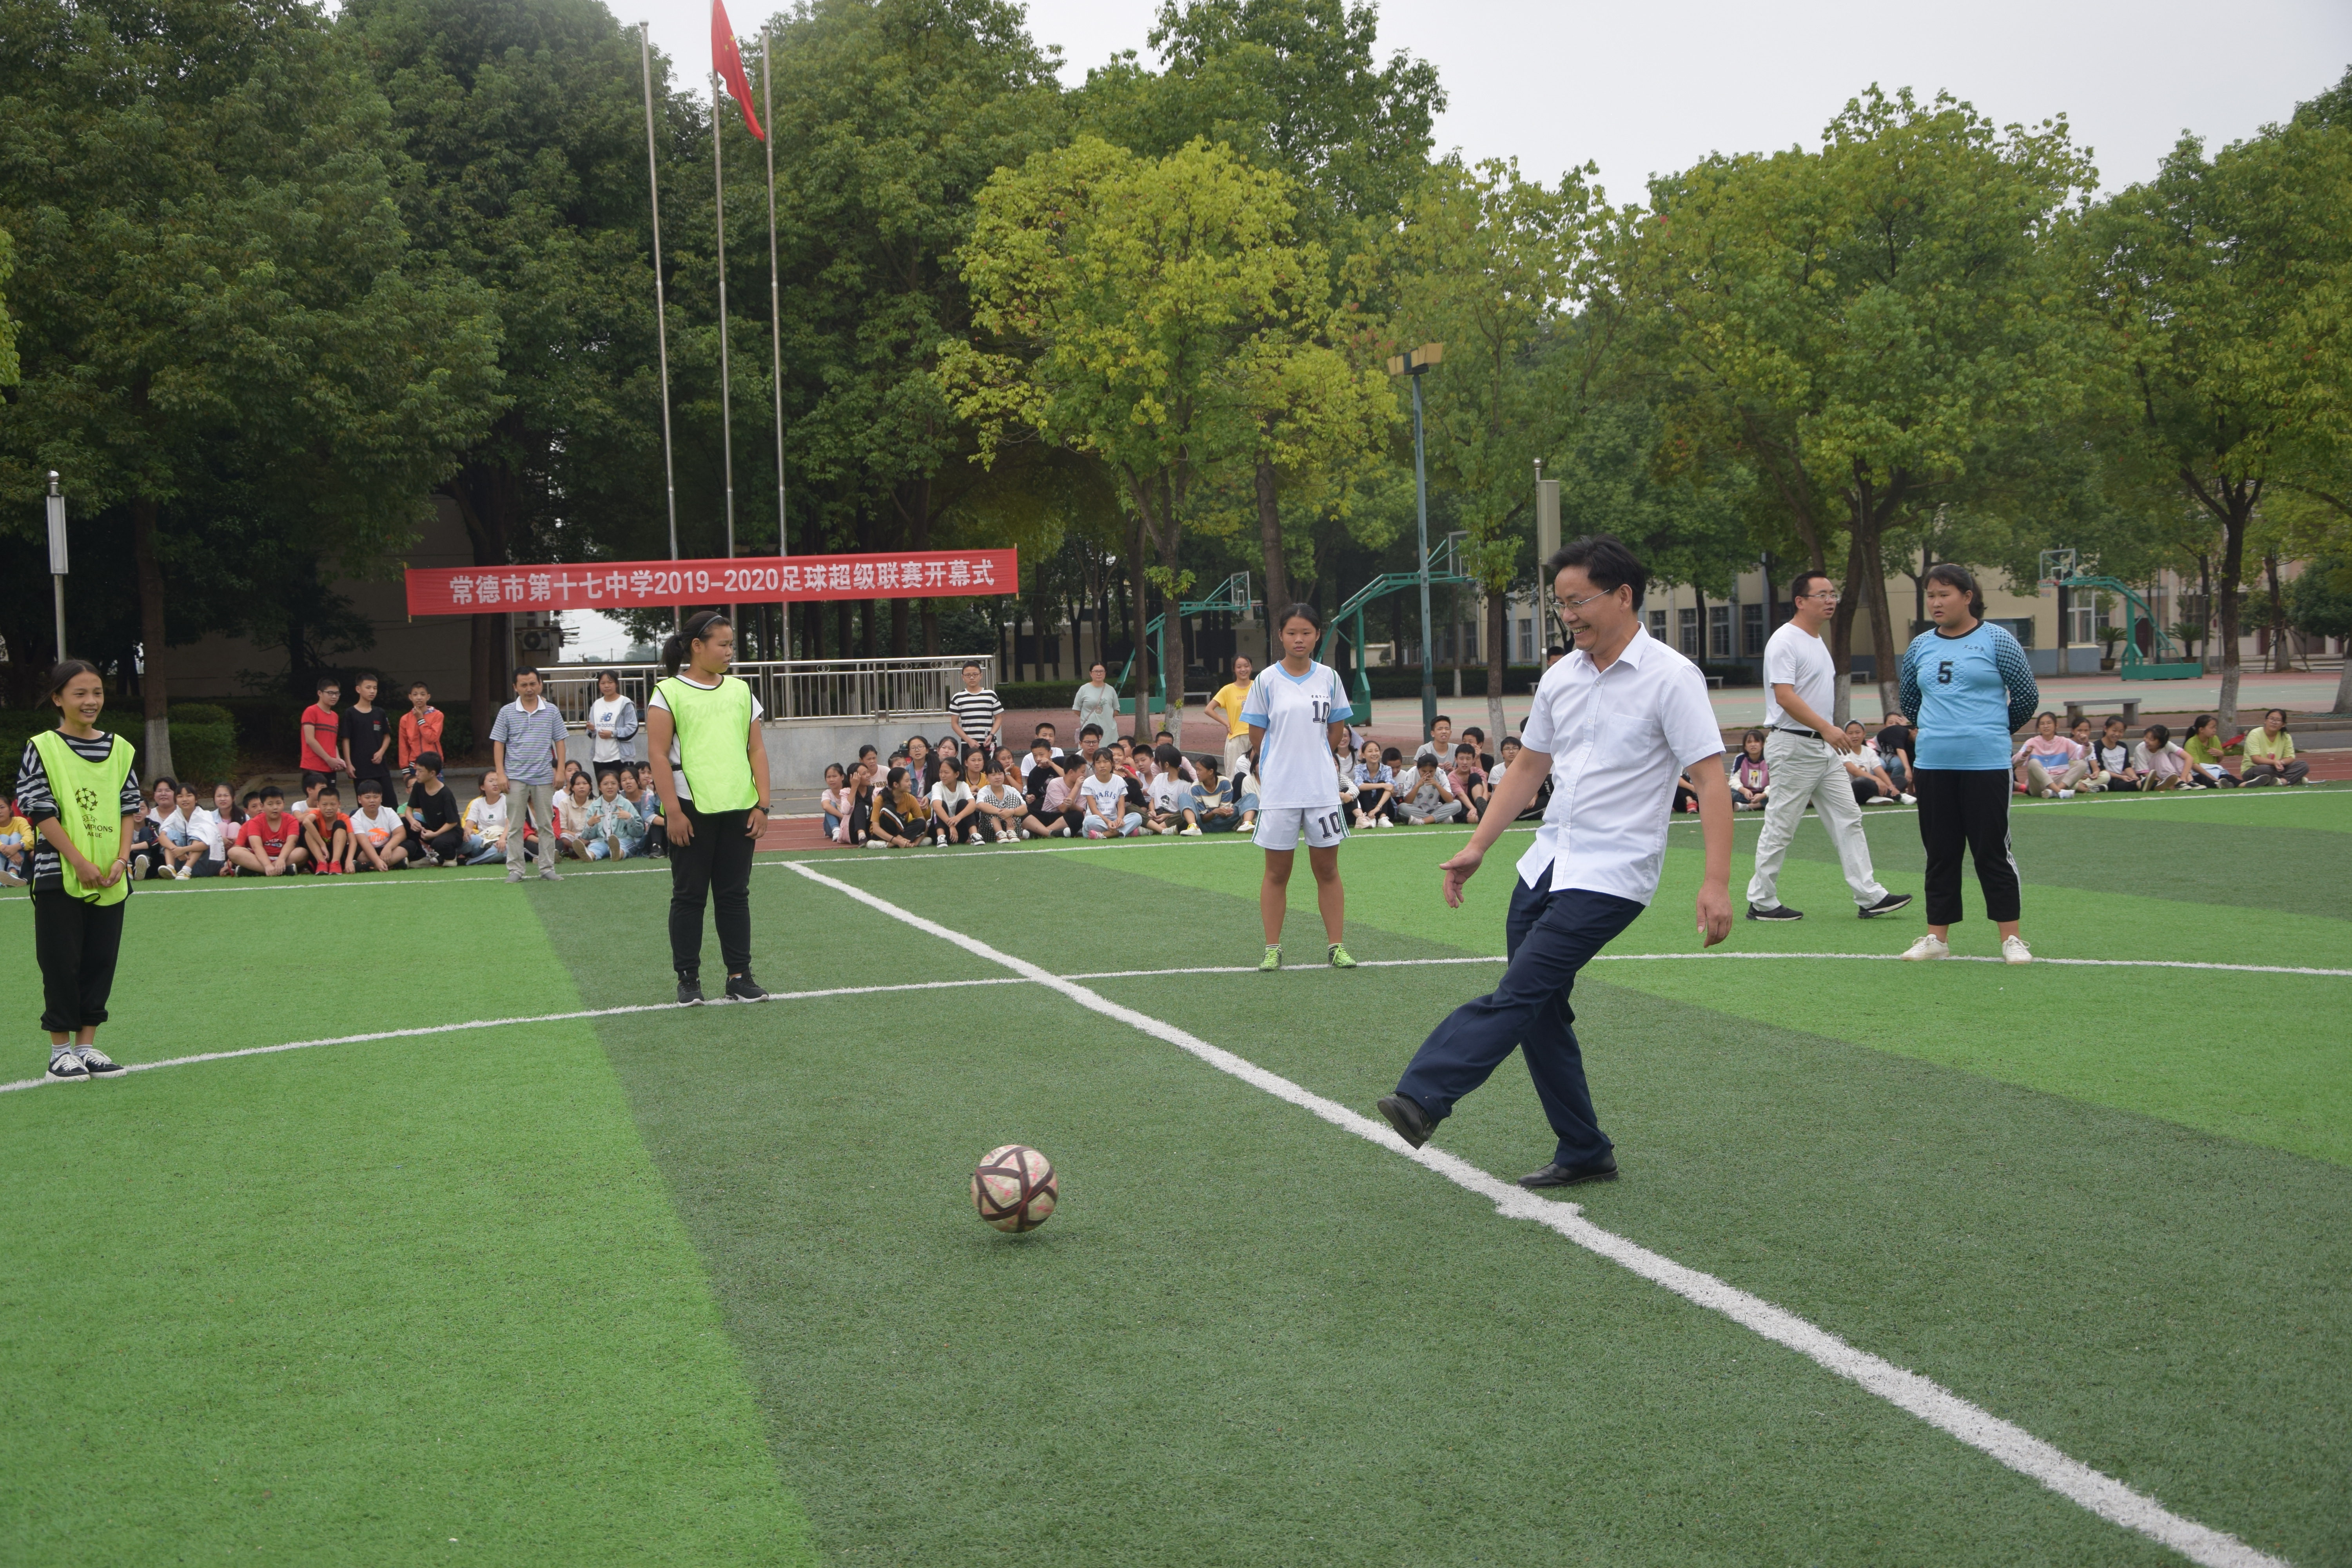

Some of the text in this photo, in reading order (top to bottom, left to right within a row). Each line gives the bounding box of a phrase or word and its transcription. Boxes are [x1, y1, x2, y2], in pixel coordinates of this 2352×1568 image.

[1938, 661, 1953, 684] 5
[1312, 701, 1330, 724] 10
[1318, 811, 1340, 839] 10
